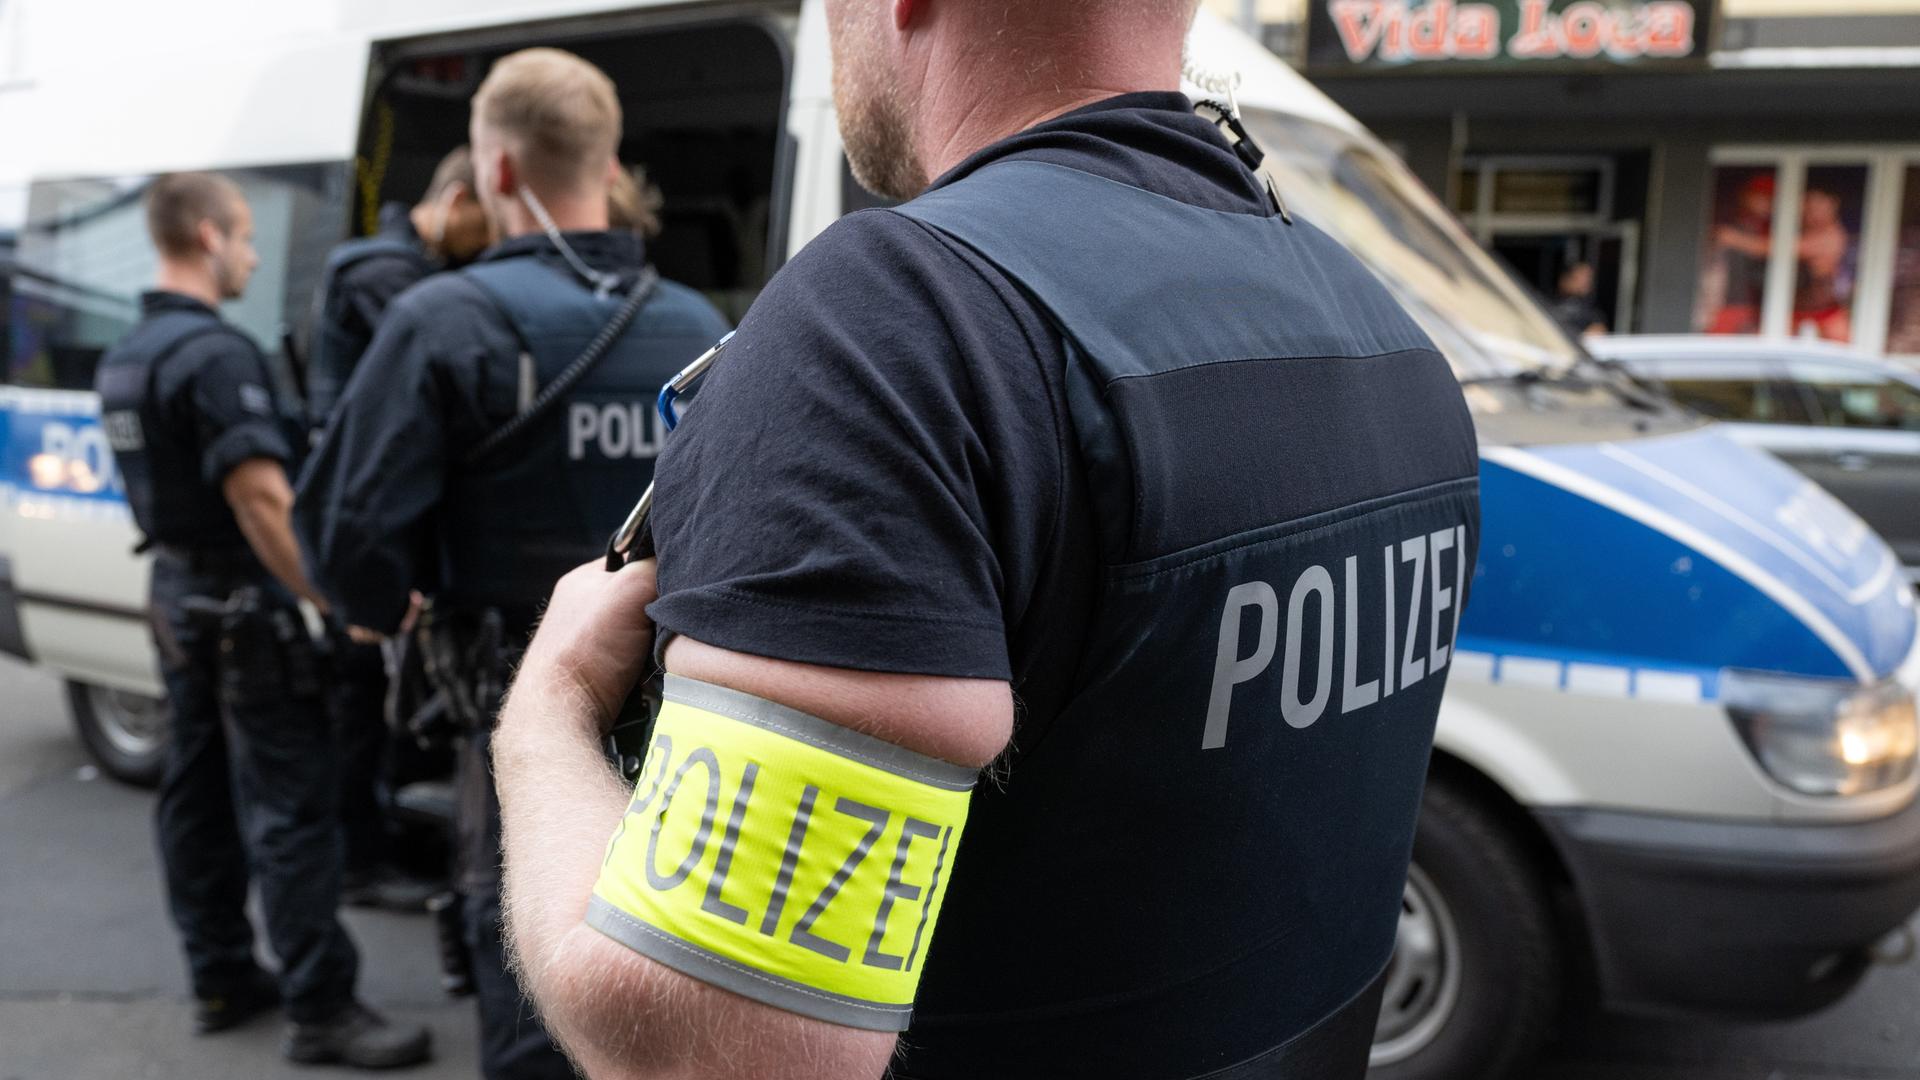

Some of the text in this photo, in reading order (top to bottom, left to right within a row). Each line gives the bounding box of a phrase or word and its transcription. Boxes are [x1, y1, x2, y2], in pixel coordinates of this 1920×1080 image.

[1327, 0, 1694, 63] Vida Loca
[1201, 525, 1466, 750] POLIZEI
[605, 734, 953, 972] POLIZEI
